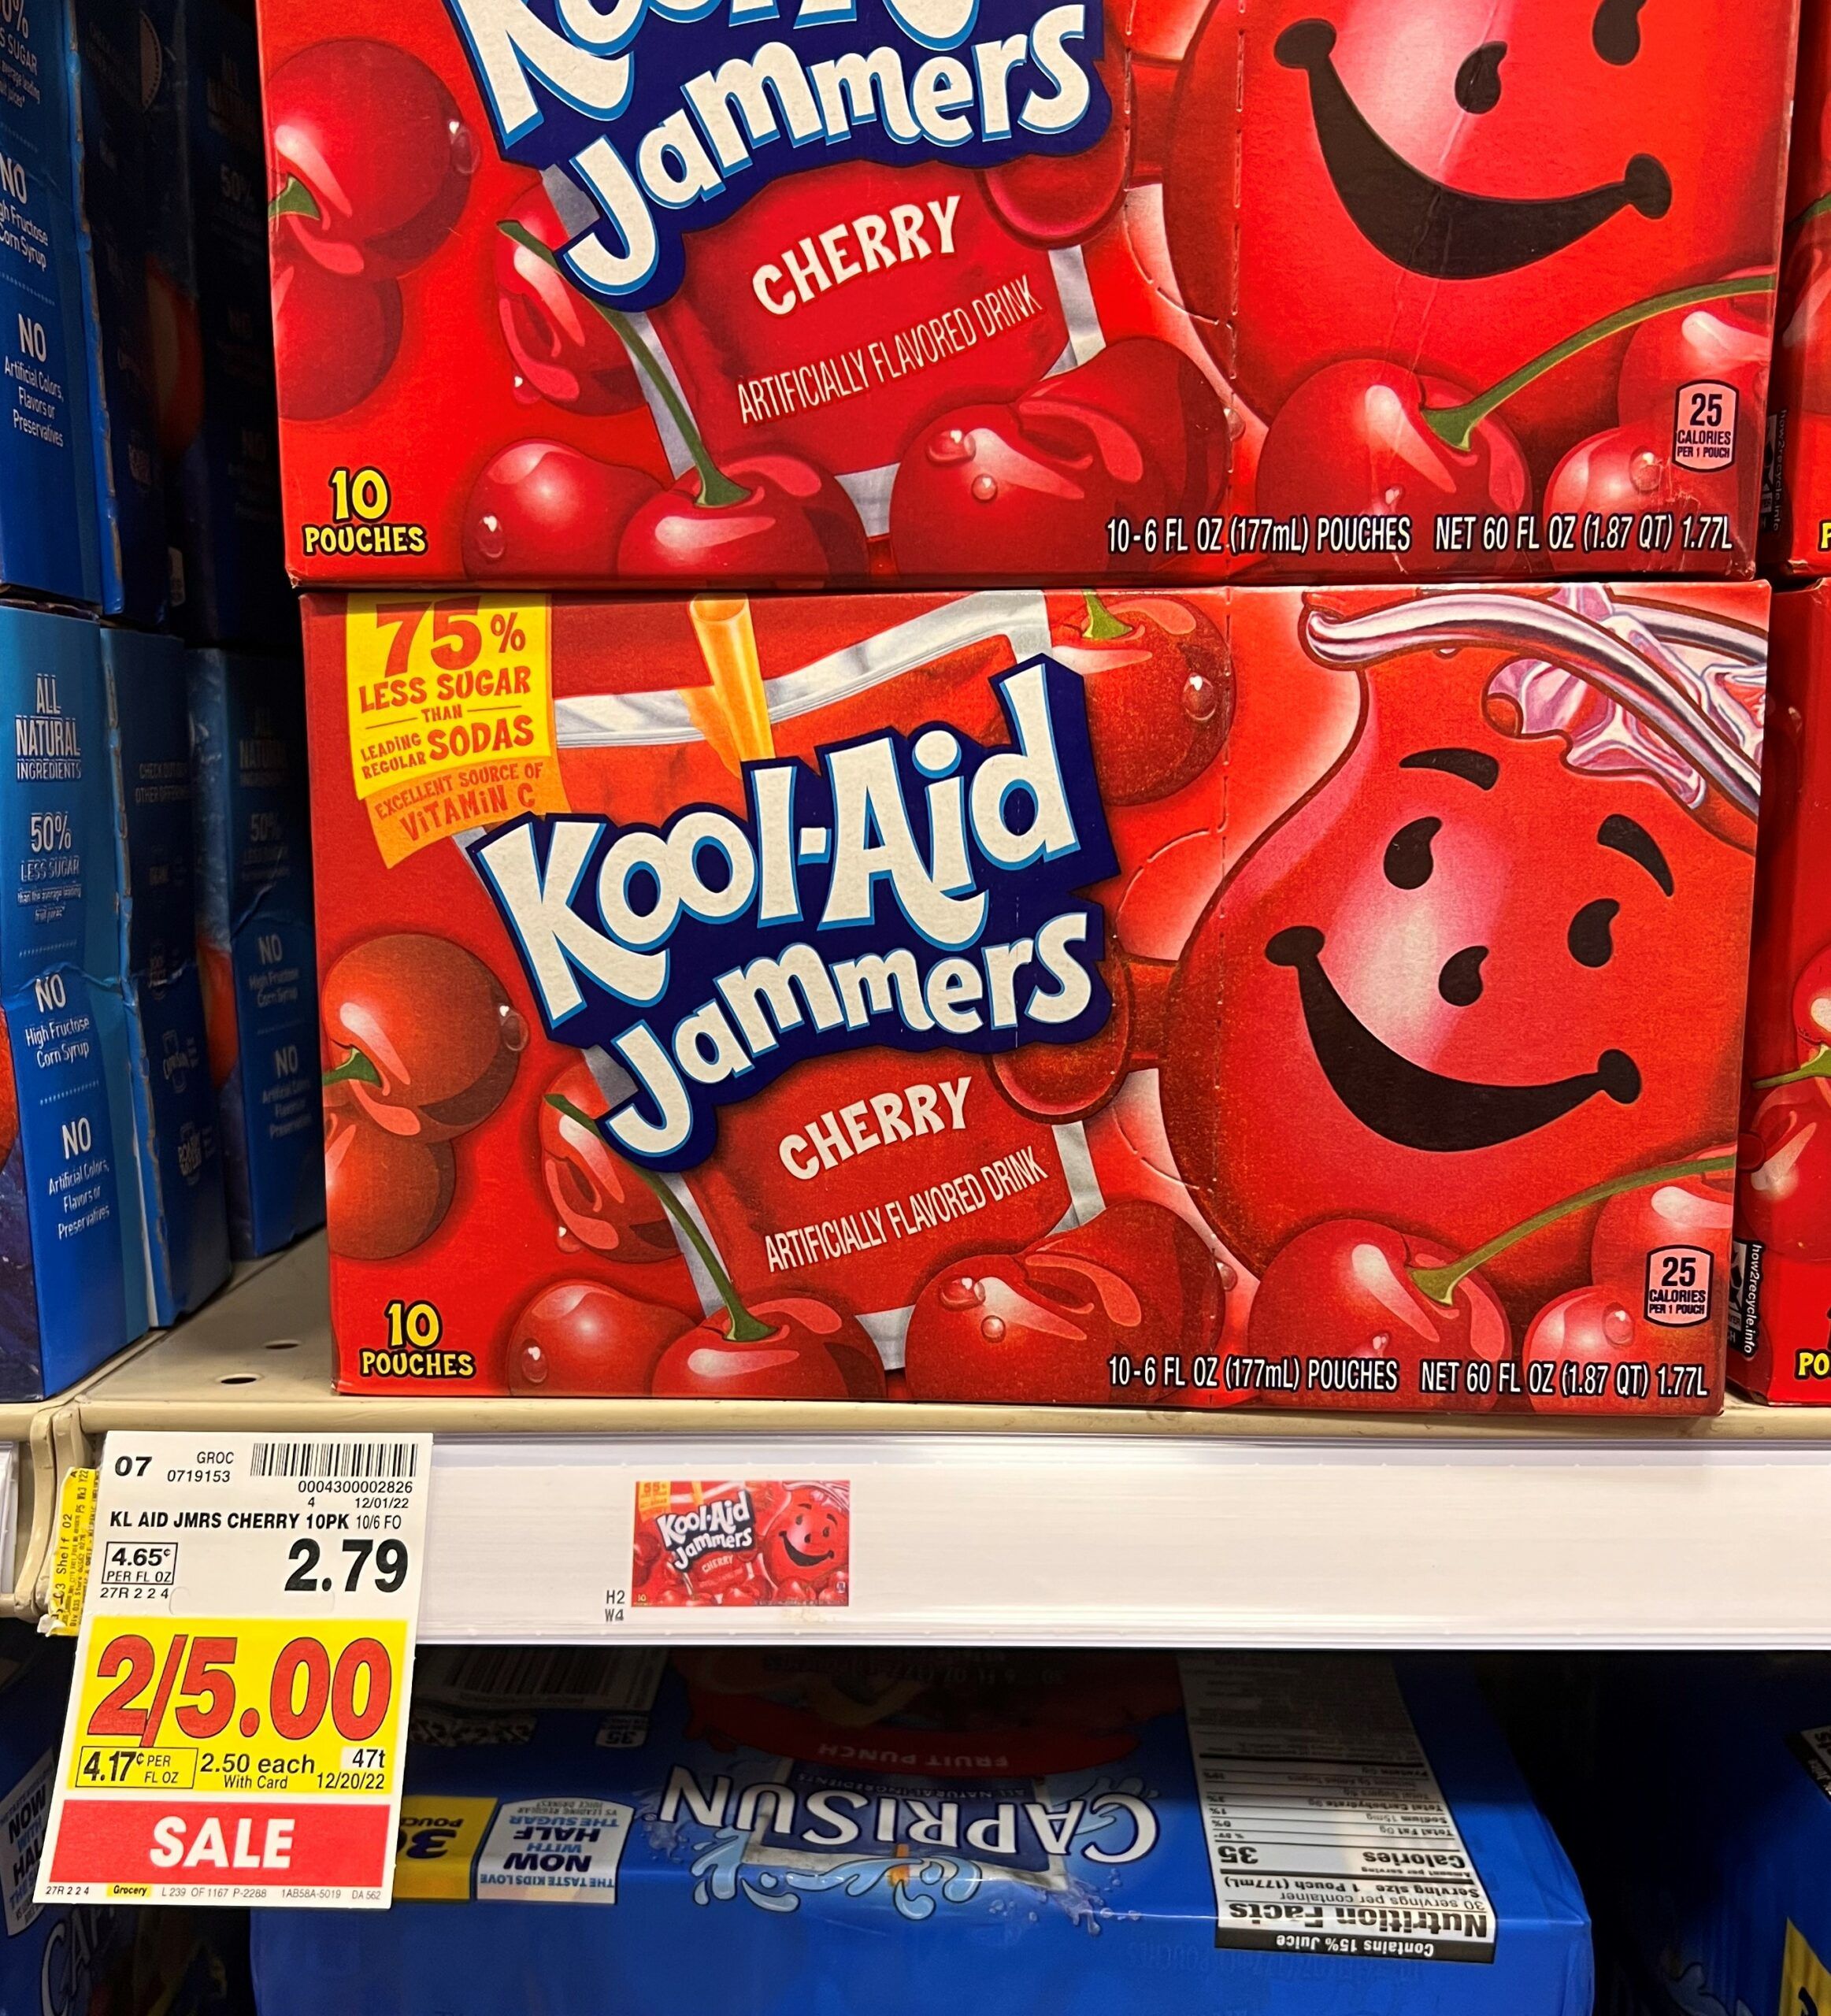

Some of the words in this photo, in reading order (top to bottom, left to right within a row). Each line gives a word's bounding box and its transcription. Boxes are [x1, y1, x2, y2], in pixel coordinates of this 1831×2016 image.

[561, 4, 1092, 294] Jammers
[0, 151, 27, 204] NO
[10, 205, 48, 246] Fructose
[20, 235, 46, 272] Syrup
[752, 194, 962, 315] CHERRY
[18, 313, 47, 362] NO
[738, 354, 872, 425] ARTIFICIALLY
[873, 309, 977, 385] FLAVORED
[979, 276, 1043, 354] DRINK
[4, 355, 38, 389] Artificial
[39, 371, 64, 402] Colors,
[18, 386, 47, 416] Flavors
[47, 402, 55, 420] or
[1689, 393, 1723, 427] 25
[13, 409, 64, 447] Preservatives
[1677, 430, 1731, 445] CALORIES
[1677, 447, 1694, 457] PER
[1696, 447, 1701, 457] 1
[1703, 447, 1730, 458] POUCH
[329, 469, 390, 521] 10
[305, 525, 426, 554] POUCHES
[1166, 518, 1188, 552] FL
[1196, 517, 1224, 552] OZ
[1230, 516, 1309, 554] (177mL)
[1317, 516, 1411, 552] POUCHES
[1435, 516, 1477, 550] NET
[1483, 517, 1509, 550] 60
[1517, 516, 1539, 550] FL
[1548, 515, 1575, 550] OZ
[1582, 514, 1633, 551] (1.87
[1639, 514, 1674, 551] QT)
[1682, 516, 1733, 550] 1.77L
[375, 596, 527, 679] 75%
[36, 675, 61, 714] ALL
[358, 677, 428, 714] LESS
[436, 666, 532, 701] SUGAR
[421, 703, 463, 723] THAN
[16, 715, 81, 756] NATURAL
[428, 715, 535, 761] SODAS
[17, 758, 81, 780] INGREDIENTS
[361, 751, 426, 780] REGULAR
[374, 774, 454, 821] EXCELLENT
[458, 763, 520, 788] SOURCE
[524, 762, 543, 779] OF
[517, 782, 536, 807] C
[30, 812, 72, 852] 50%
[478, 663, 1078, 1024] Kool-Aid
[20, 858, 46, 882] LESS
[48, 854, 80, 879] SUGAR
[258, 934, 283, 965] NO
[35, 973, 66, 1013] NO
[24, 1025, 50, 1050] High
[49, 1017, 90, 1039] Fructose
[605, 912, 1092, 1157] Jammers
[36, 1050, 61, 1069] Corn
[61, 1041, 90, 1064] Syrup
[273, 1044, 298, 1079] NO
[61, 1117, 91, 1159] NO
[778, 1076, 973, 1180] CHERRY
[49, 1169, 83, 1196] Artificial
[83, 1159, 109, 1180] Colors,
[63, 1189, 93, 1214] Flavors
[93, 1185, 101, 1199] or
[763, 1206, 889, 1273] ARTIFICIALLY
[890, 1171, 986, 1241] FLAVORED
[987, 1146, 1048, 1208] DRINK
[57, 1205, 110, 1240] Preservatives
[1661, 1257, 1696, 1287] 25
[1648, 1289, 1706, 1303] CALORIES
[1744, 1243, 1762, 1354] how2recycle.info
[1648, 1304, 1666, 1314] PER
[1668, 1304, 1673, 1314] 1
[1675, 1304, 1705, 1315] POUCH
[387, 1302, 440, 1347] 10
[361, 1351, 474, 1377] POUCHES
[1164, 1357, 1186, 1387] FL
[1193, 1357, 1218, 1387] OZ
[1225, 1356, 1300, 1390] (177mL)
[1307, 1359, 1398, 1391] POUCHES
[1421, 1361, 1459, 1392] NET
[1466, 1362, 1491, 1392] 60
[1499, 1362, 1522, 1393] FL
[1529, 1363, 1554, 1393] OZ
[1562, 1363, 1609, 1395] (1.87
[1616, 1364, 1649, 1396] QT)
[1657, 1366, 1708, 1395] 1.77L
[114, 1455, 153, 1477] 07
[197, 1451, 234, 1464] GROC
[167, 1469, 230, 1482] 0719153
[298, 1480, 413, 1493] 0004300002826
[307, 1496, 315, 1507] 4
[354, 1497, 409, 1509] 12/01/22
[62, 1513, 73, 1529] 02
[110, 1511, 132, 1527] KL
[138, 1512, 169, 1527] AID
[173, 1512, 222, 1528] JMRS
[227, 1512, 300, 1529] CHERRY
[306, 1514, 350, 1529] 10PK
[356, 1514, 380, 1529] 10/6
[384, 1514, 402, 1529] FO
[657, 1491, 751, 1547] Kool-Aid
[57, 1536, 70, 1575] Shelf
[674, 1528, 752, 1569] Jammers
[106, 1570, 132, 1582] PER
[136, 1571, 150, 1582] FL
[155, 1571, 172, 1582] OZ
[284, 1538, 408, 1592] 2.79
[701, 1555, 733, 1573] CHERRY
[100, 1588, 129, 1599] 27R
[134, 1588, 143, 1599] 2
[147, 1588, 156, 1599] 2
[161, 1588, 169, 1599] 4
[606, 1590, 626, 1605] H2
[605, 1609, 625, 1622] W4
[87, 1634, 392, 1747] 2/5.00
[146, 1754, 171, 1767] PER
[200, 1753, 250, 1773] 2.50
[258, 1754, 315, 1774] each
[352, 1749, 386, 1769] 47t
[817, 1742, 917, 1766] PUNCH
[925, 1754, 1010, 1769] FRUIT
[144, 1771, 158, 1784] FL
[161, 1771, 179, 1784] OZ
[223, 1775, 253, 1789] With
[256, 1775, 288, 1790] Card
[317, 1771, 385, 1790] 12/20/22
[8, 1784, 46, 1844] NOW
[509, 1815, 577, 1826] SUGAR
[579, 1817, 619, 1827] THE
[150, 1816, 295, 1869] SALE
[513, 1826, 601, 1842] HALF
[13, 1829, 46, 1887] HAL
[525, 1843, 582, 1853] WITH
[1218, 1845, 1259, 1865] 35
[1362, 1851, 1466, 1869] Calories
[503, 1852, 591, 1872] NOW
[46, 1886, 65, 1896] 27R
[67, 1886, 73, 1896] 2
[75, 1886, 81, 1896] 2
[83, 1886, 90, 1896] 4
[113, 1884, 148, 1897] Grocery
[480, 1873, 513, 1884] LOVE
[515, 1874, 546, 1885] KIDS
[547, 1876, 587, 1887] TASTE
[589, 1877, 615, 1888] THE
[1225, 1876, 1289, 1889] (177mL)
[1296, 1879, 1344, 1892] Pouch
[1351, 1881, 1361, 1893] 1
[1375, 1883, 1409, 1895] size
[1413, 1884, 1480, 1898] Serving
[169, 1887, 186, 1897] 239
[191, 1888, 206, 1898] OF
[208, 1888, 228, 1898] 1167
[233, 1888, 267, 1898] P-2288
[352, 1890, 363, 1900] DA
[366, 1890, 381, 1900] 562
[1279, 1891, 1354, 1903] container
[1360, 1893, 1385, 1906] per
[1391, 1895, 1458, 1909] servings
[1229, 1902, 1324, 1928] Facts
[1462, 1900, 1485, 1911] 30
[1334, 1907, 1488, 1938] Nutrition
[1275, 1933, 1322, 1951] Juice
[1324, 1937, 1358, 1953] 15%
[1363, 1939, 1435, 1956] Contains
